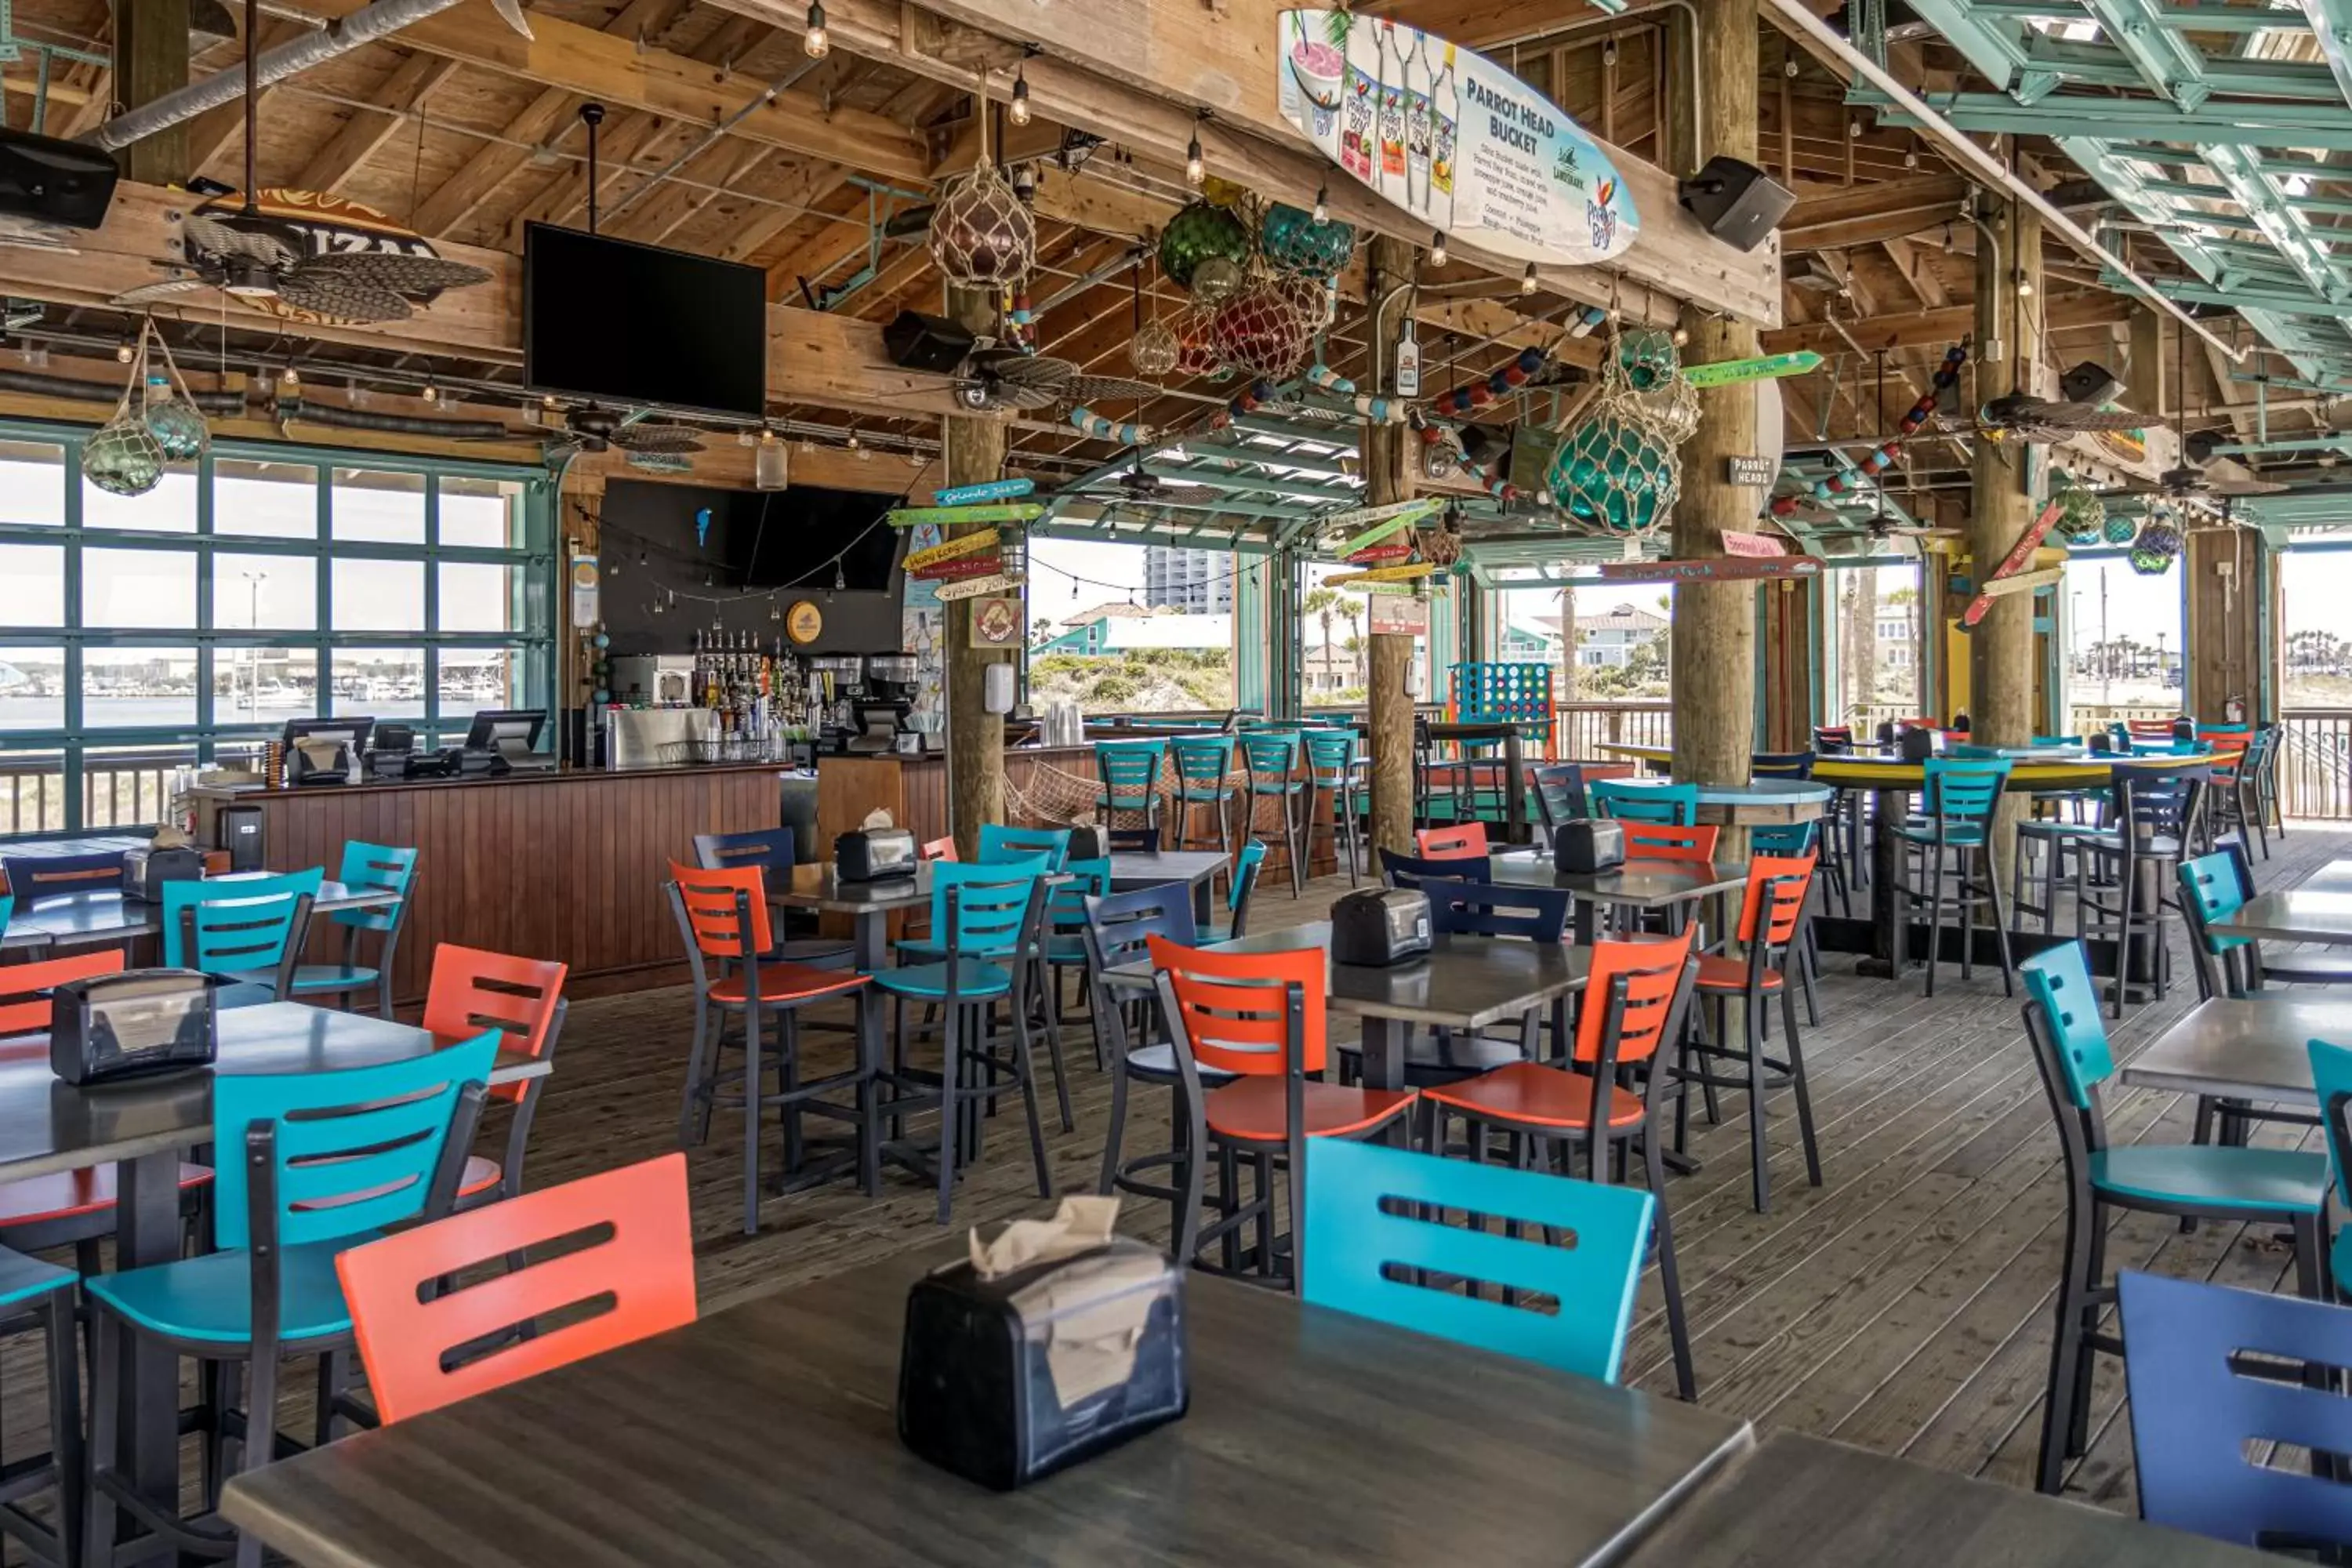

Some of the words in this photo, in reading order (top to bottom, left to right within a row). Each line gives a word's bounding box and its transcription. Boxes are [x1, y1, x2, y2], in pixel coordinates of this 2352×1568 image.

[1468, 77, 1518, 121] PARROT
[1521, 104, 1555, 139] HEAD
[1490, 115, 1537, 157] BUCKET
[1735, 459, 1769, 471] PARROT
[1738, 473, 1767, 484] HEADS
